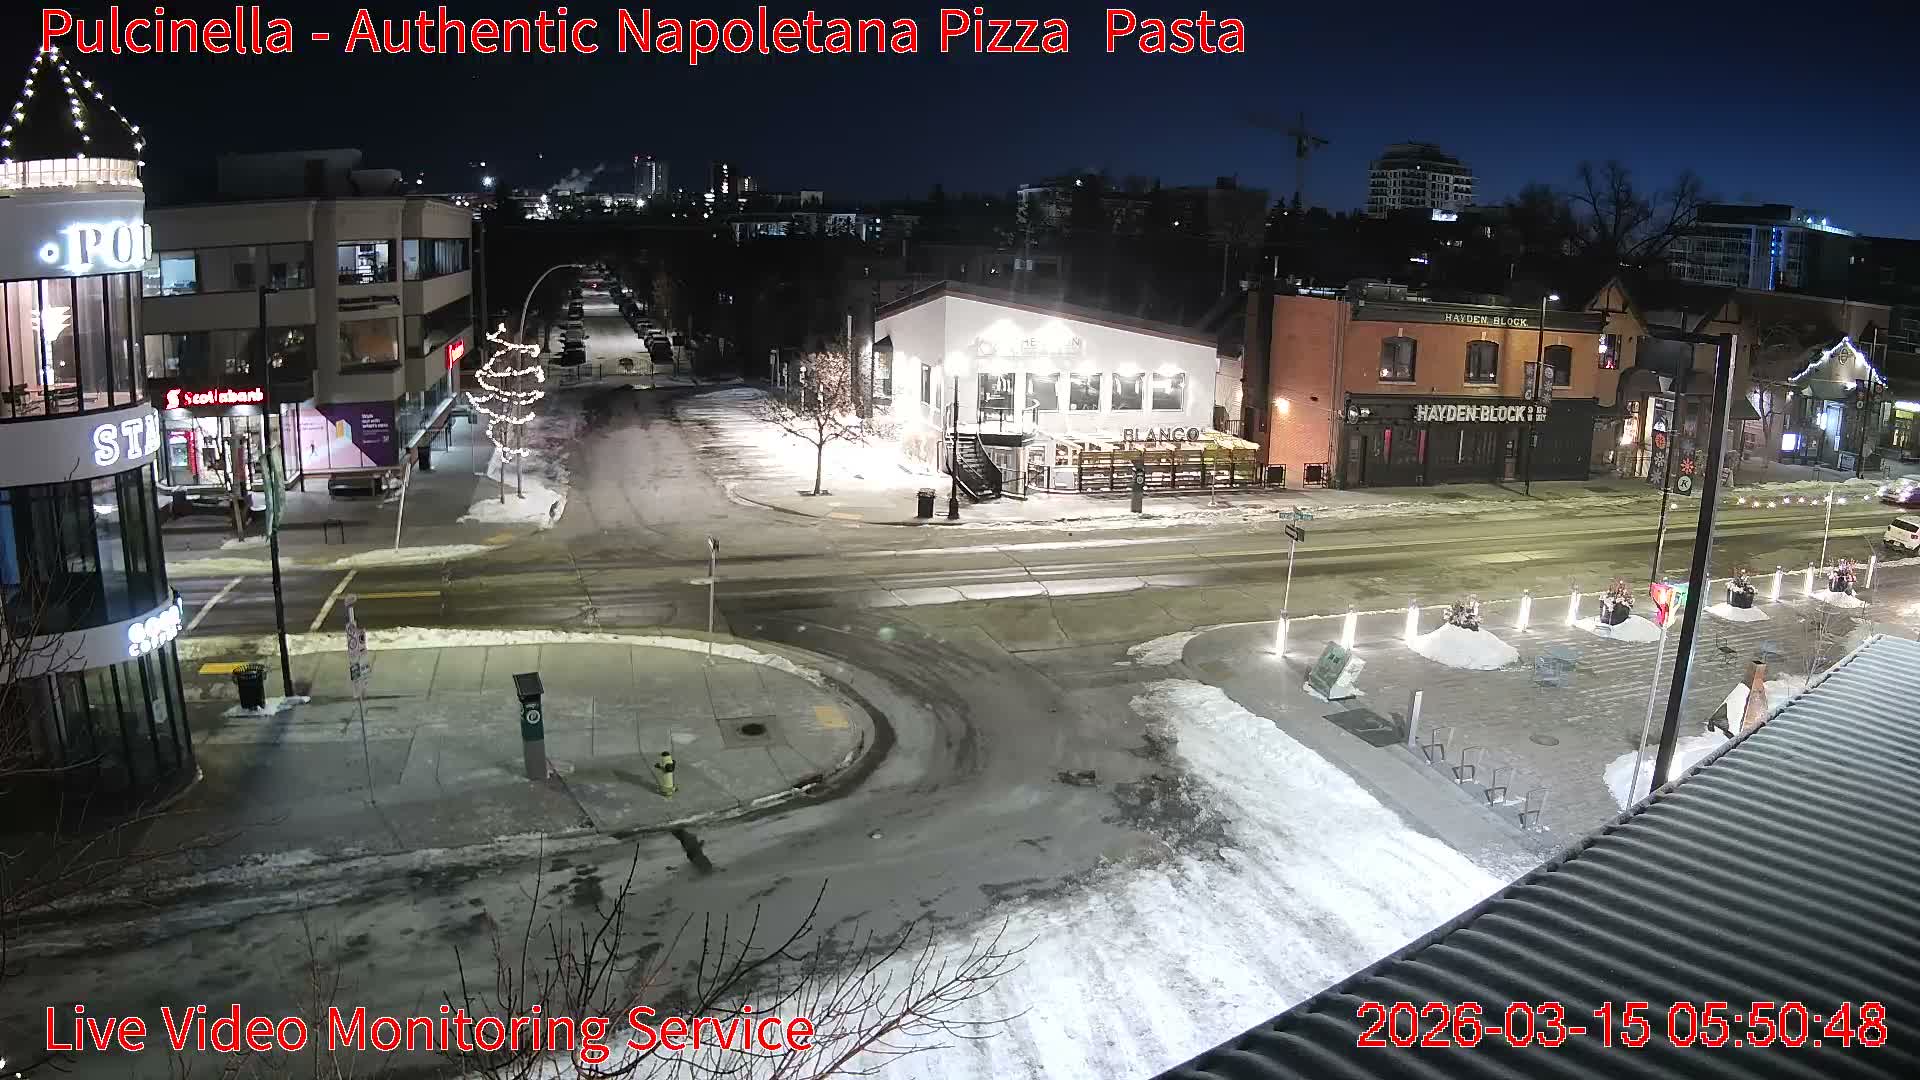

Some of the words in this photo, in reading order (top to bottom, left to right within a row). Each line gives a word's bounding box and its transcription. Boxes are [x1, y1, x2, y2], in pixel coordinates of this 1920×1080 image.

[1416, 404, 1478, 422] HAYDEN
[1479, 404, 1526, 422] BLOCK
[1123, 427, 1200, 442] BLANCO
